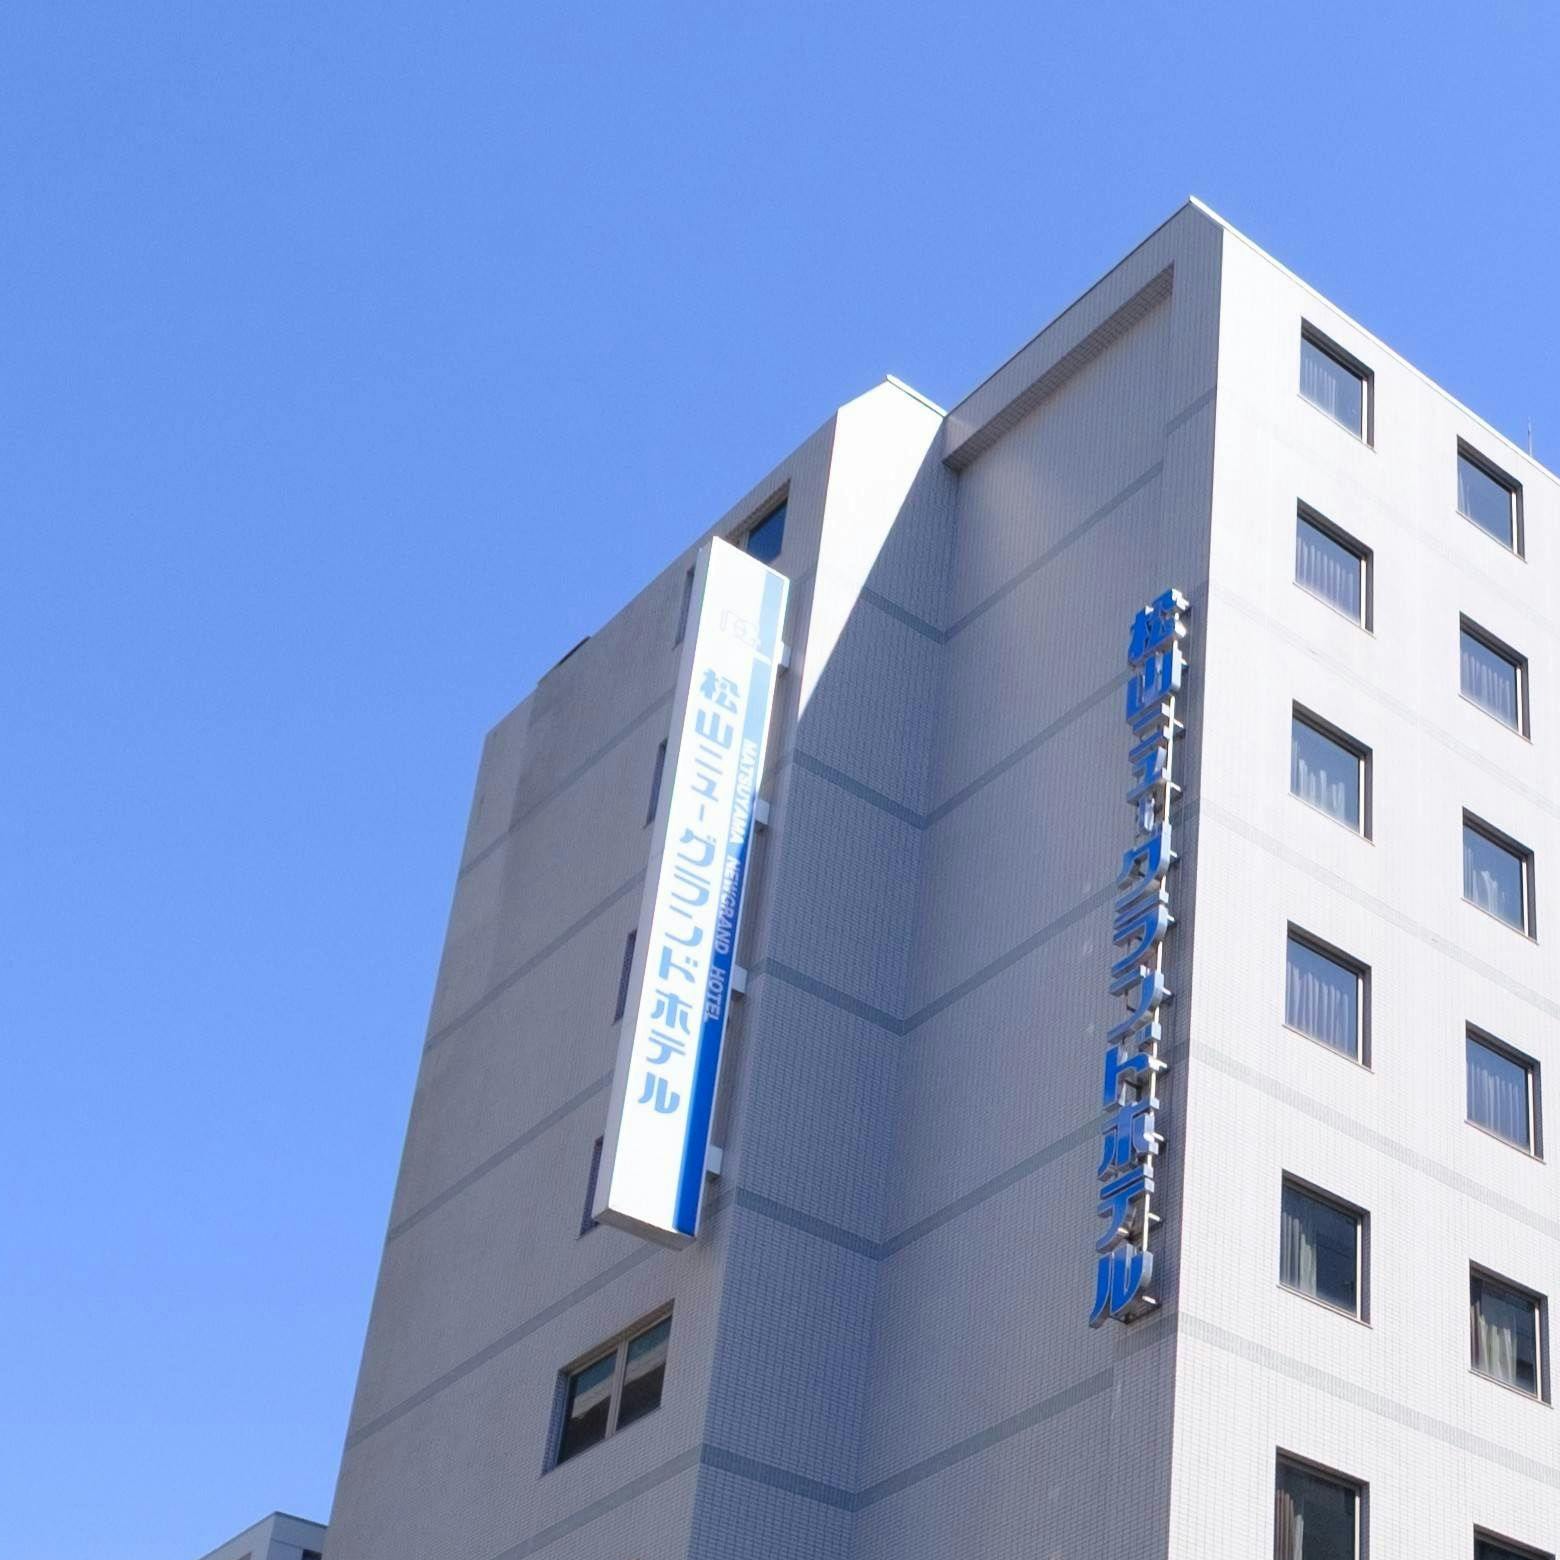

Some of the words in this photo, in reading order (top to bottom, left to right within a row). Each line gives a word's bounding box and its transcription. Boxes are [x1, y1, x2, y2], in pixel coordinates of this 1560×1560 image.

[638, 667, 740, 1114] 松山ニューグランドホテル
[705, 965, 727, 1022] HOTEL
[1090, 588, 1185, 1328] 松山ニューグランドホテル
